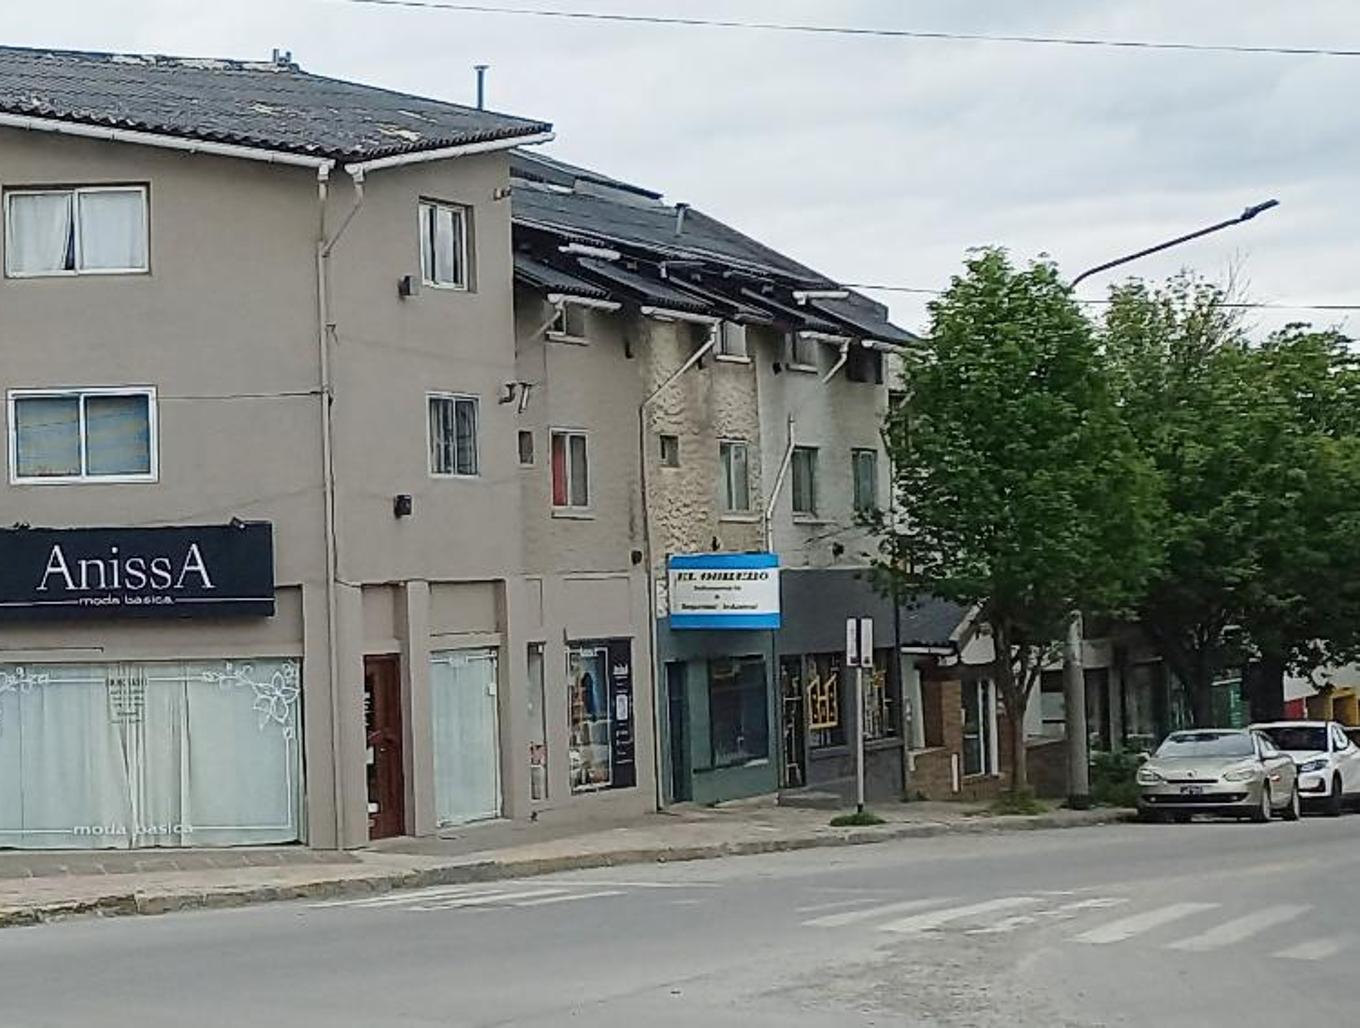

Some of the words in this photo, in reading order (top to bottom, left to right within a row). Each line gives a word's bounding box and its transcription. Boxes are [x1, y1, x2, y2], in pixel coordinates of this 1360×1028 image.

[36, 544, 216, 590] AnissA
[79, 593, 121, 607] moda
[124, 594, 175, 606] basica
[73, 823, 128, 835] moda
